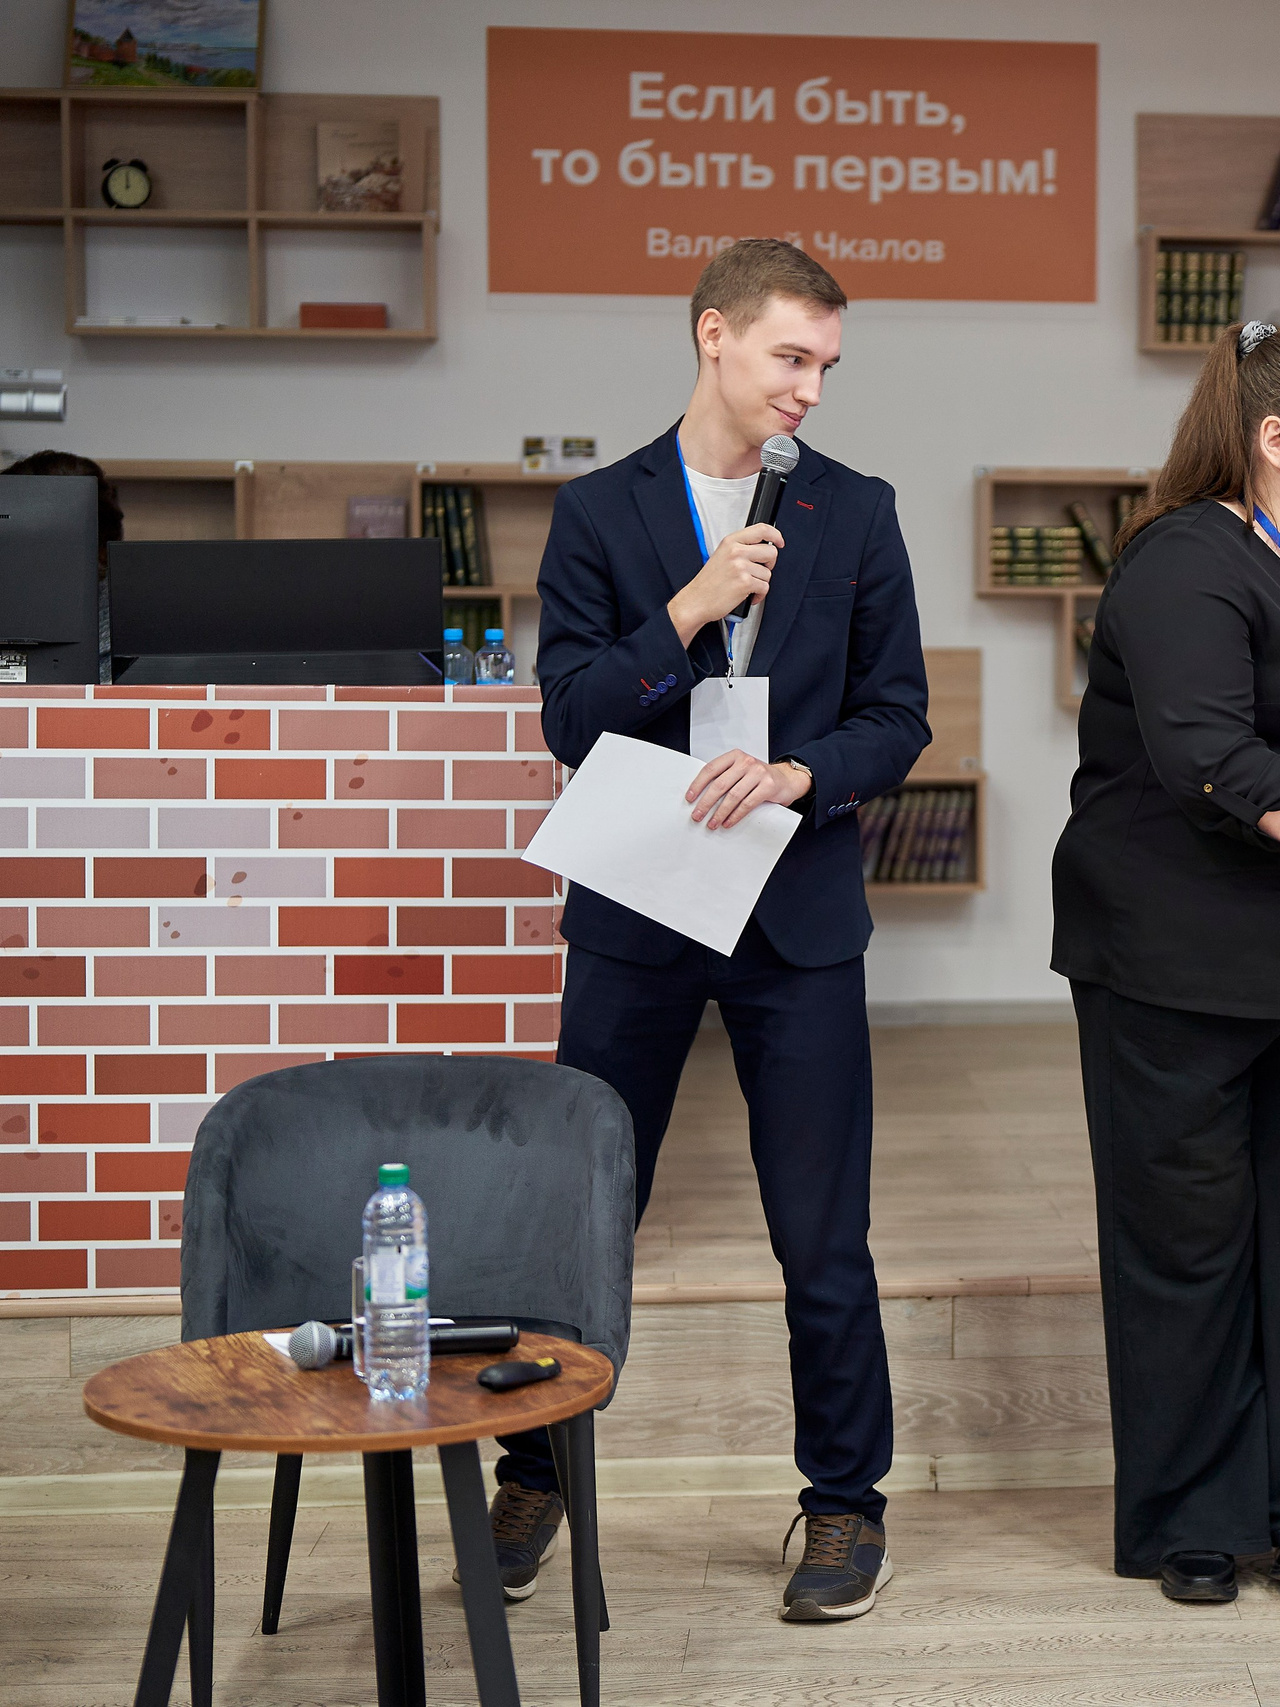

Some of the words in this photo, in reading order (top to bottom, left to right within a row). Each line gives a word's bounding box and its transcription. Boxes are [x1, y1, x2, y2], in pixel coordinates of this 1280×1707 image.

[628, 71, 775, 123] Если
[794, 75, 967, 135] быть,
[531, 148, 600, 187] то
[617, 138, 775, 190] быть
[793, 147, 1058, 204] первым!
[646, 227, 803, 259] Валей
[813, 231, 945, 262] Чкалов
